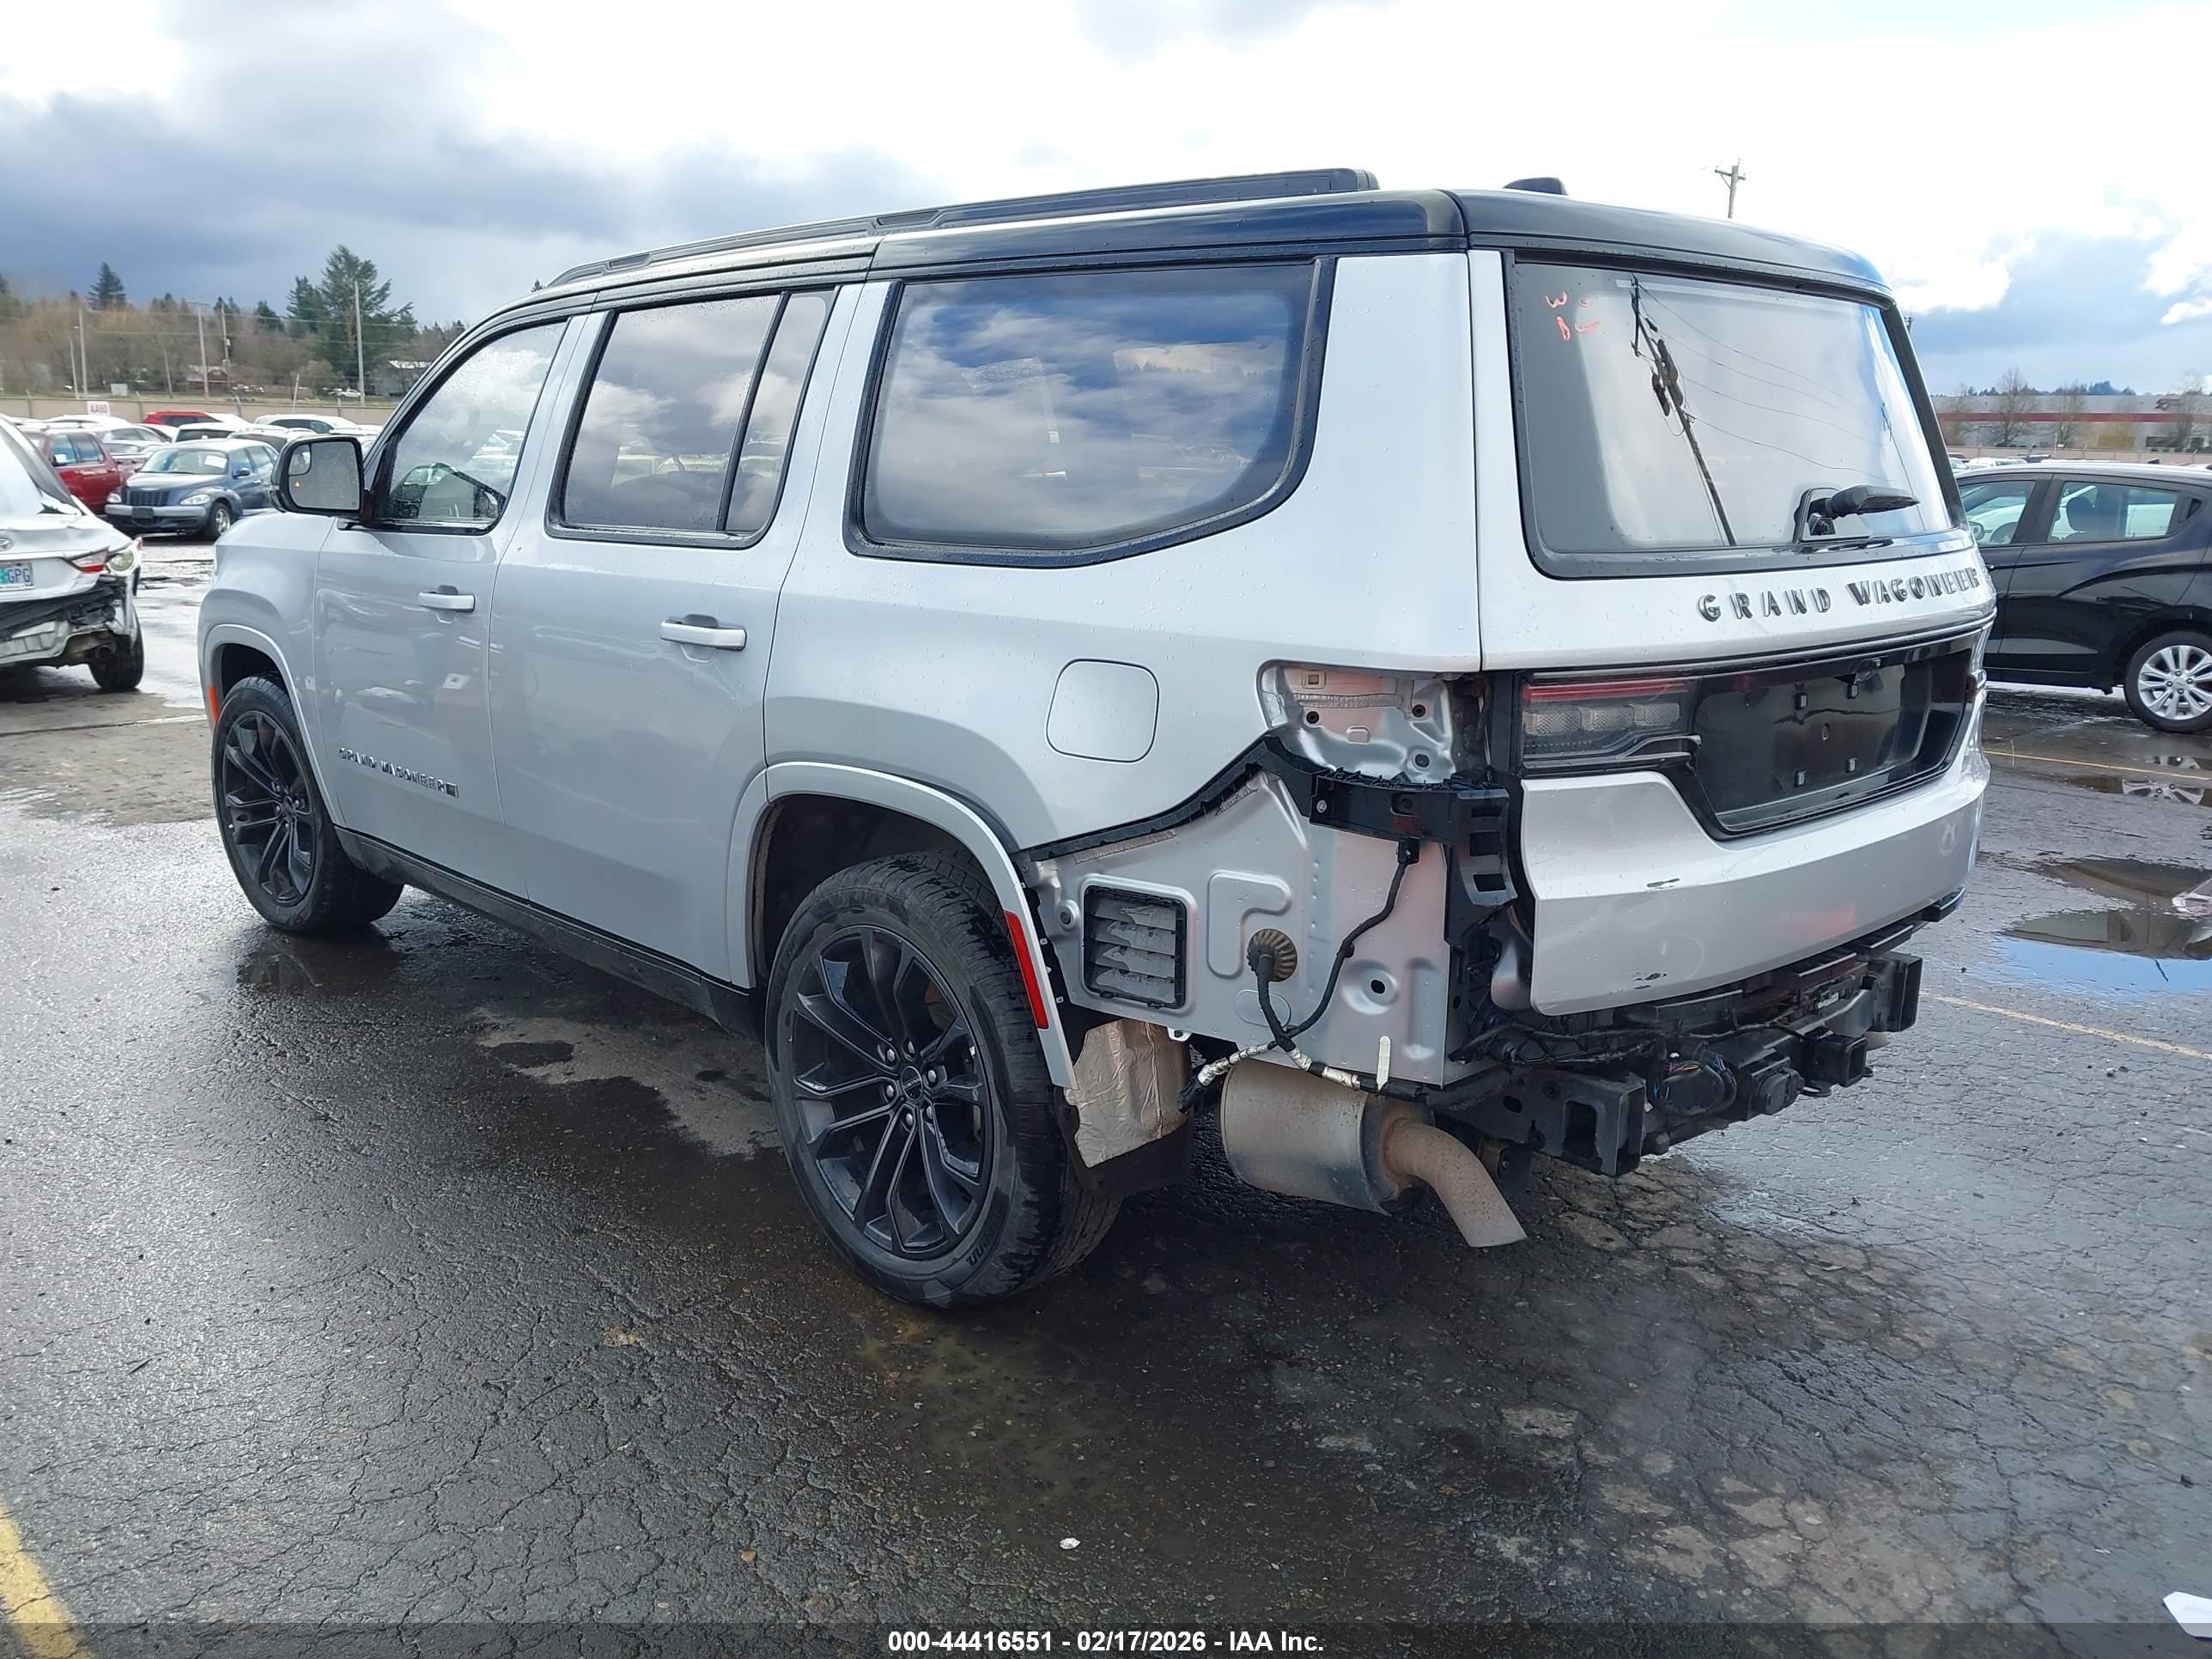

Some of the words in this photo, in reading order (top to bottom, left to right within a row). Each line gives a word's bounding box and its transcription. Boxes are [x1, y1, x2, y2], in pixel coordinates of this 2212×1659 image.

[1698, 587, 1832, 622] GRAND
[1845, 567, 1980, 606] WAGONEER
[338, 747, 376, 769] GRAND
[380, 760, 445, 792] WAGONEER
